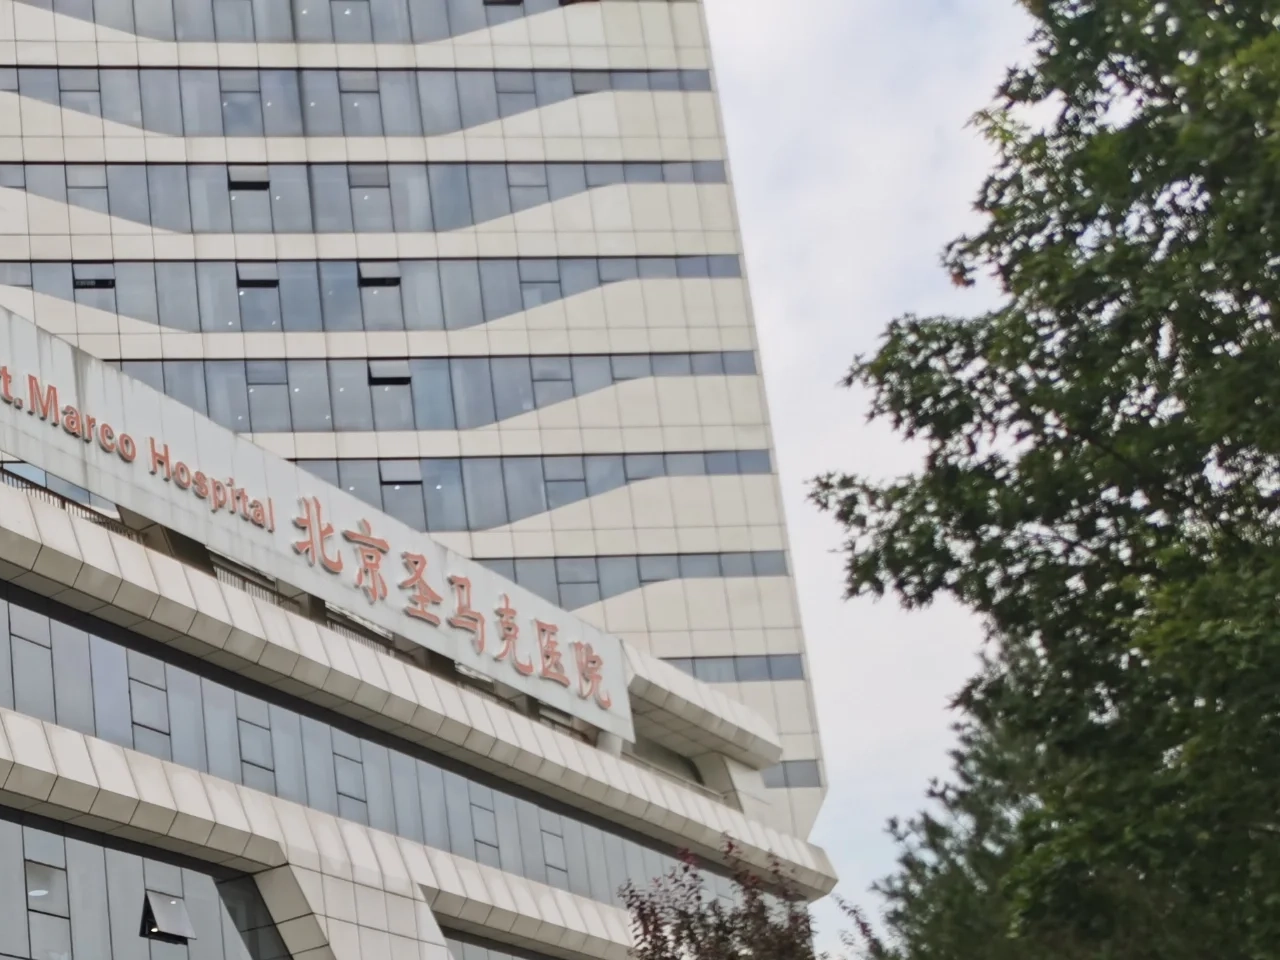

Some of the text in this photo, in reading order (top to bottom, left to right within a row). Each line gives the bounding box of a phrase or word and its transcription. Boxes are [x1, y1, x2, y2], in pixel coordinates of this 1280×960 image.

[149, 435, 276, 533] Hospital
[294, 495, 613, 710] 北京圣马克医院
